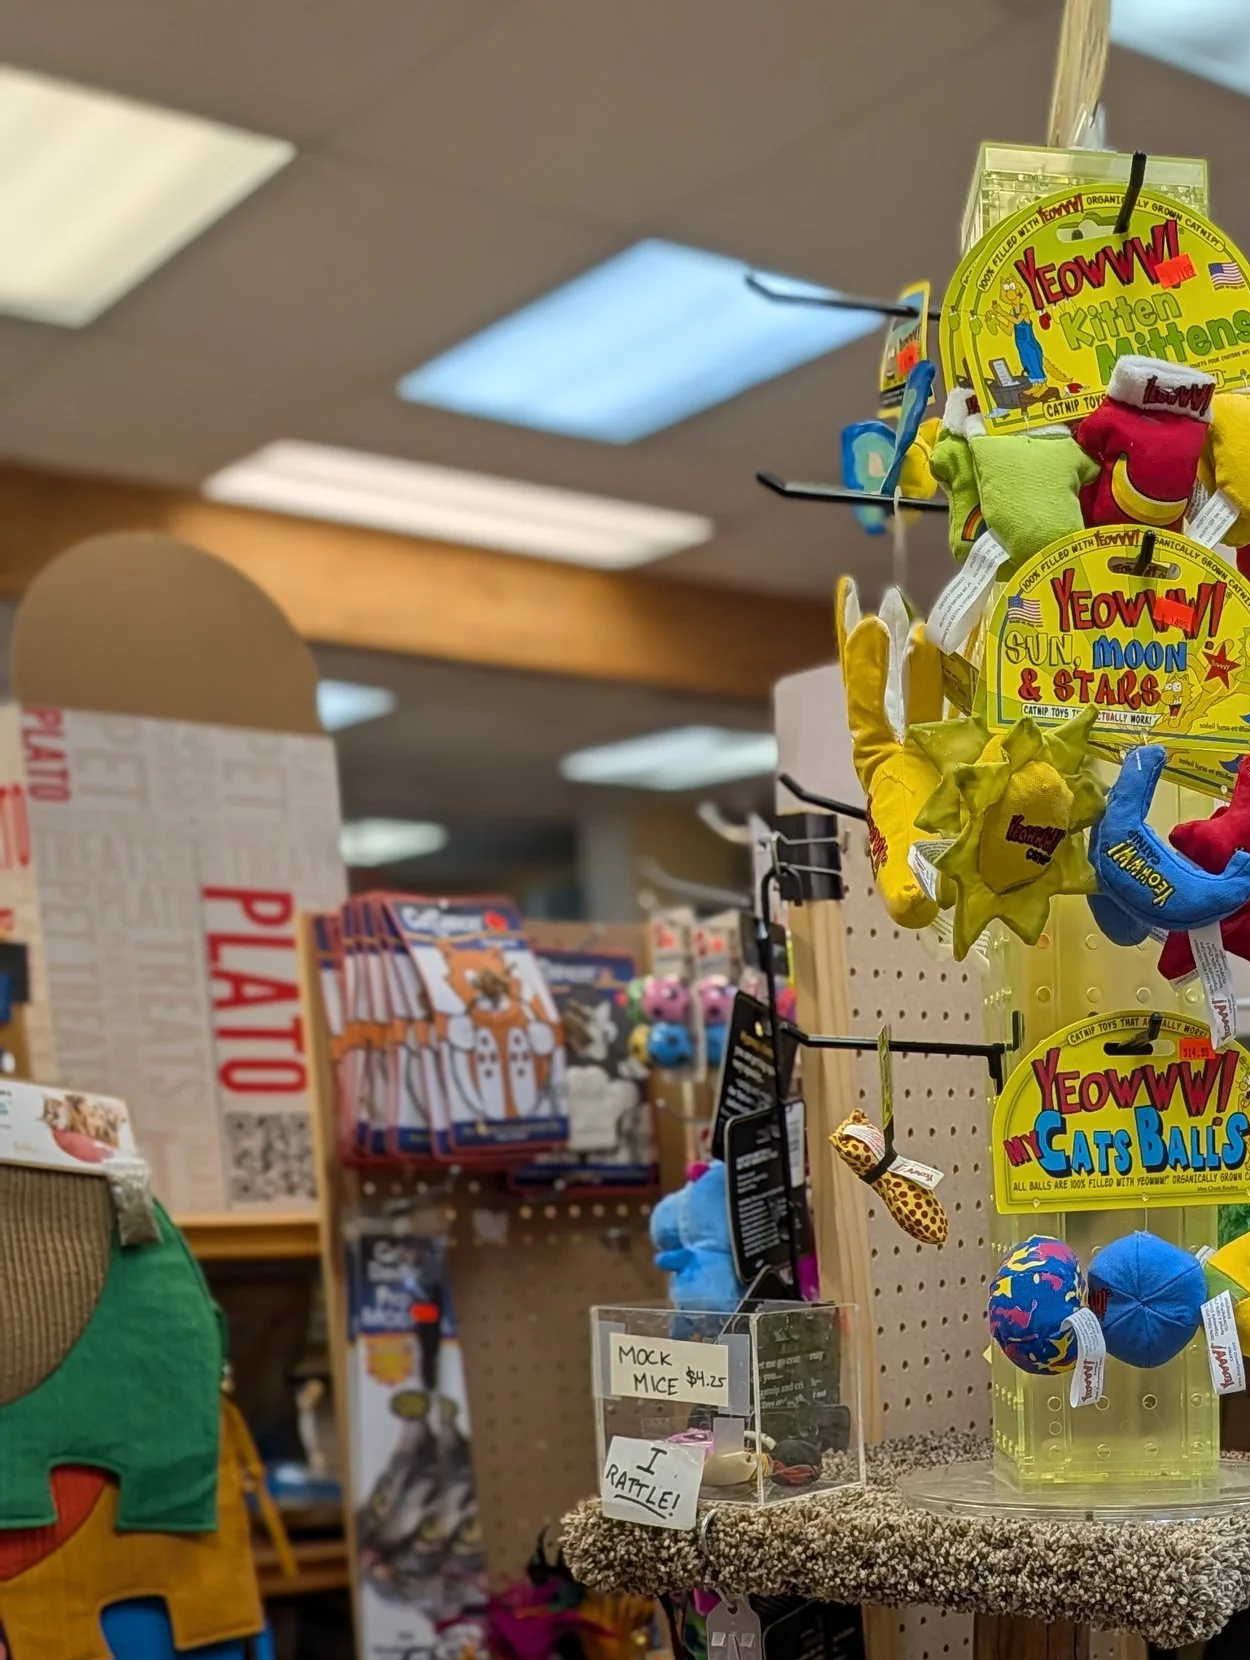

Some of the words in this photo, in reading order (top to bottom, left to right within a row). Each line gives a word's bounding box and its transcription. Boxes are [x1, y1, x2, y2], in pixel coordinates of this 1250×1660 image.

[978, 272, 995, 291] 100%
[992, 235, 1018, 267] FILLED
[1018, 217, 1040, 237] WITH
[1152, 202, 1182, 220] GROWN
[1185, 218, 1220, 246] CATNIP!
[1014, 220, 1182, 310] YEOWWW!
[1060, 292, 1182, 351] Kitten
[1046, 398, 1080, 418] CATNIP
[1022, 570, 1041, 590] 100%
[1041, 549, 1070, 572] FILLED
[1071, 540, 1095, 552] WITH
[1202, 558, 1228, 580] GROWN
[1050, 567, 1227, 649] YEOWWW!
[1005, 630, 1082, 668] SUN,
[1018, 667, 1042, 701] &
[1054, 668, 1162, 710] STARS
[1024, 705, 1048, 715] CATNIP
[1052, 707, 1069, 718] TOYS
[1130, 716, 1152, 725] WORK!
[20, 706, 70, 803] PLATO
[202, 885, 308, 1093] PLATO
[1070, 1026, 1095, 1043] CATNIP
[1099, 1020, 1117, 1031] TOYS
[1120, 1017, 1139, 1027] THAT
[1031, 1047, 1240, 1127] YEOWWW!
[1003, 1128, 1042, 1167] MY
[1033, 1109, 1133, 1176] CATS
[1135, 1105, 1250, 1175] BALLS
[1013, 1182, 1027, 1191] ALL
[1029, 1180, 1051, 1191] BALLS
[1054, 1179, 1068, 1189] ARE
[1071, 1179, 1086, 1189] 100%
[1088, 1178, 1114, 1188] FILLED
[1116, 1177, 1135, 1187] WITH
[1172, 1174, 1217, 1184] ORGANICALLY
[1220, 1173, 1243, 1182] GROWN
[619, 1346, 672, 1366] MOCK
[633, 1373, 679, 1395] MICE
[686, 1366, 726, 1388] $4.25
[636, 1447, 668, 1475] I
[606, 1464, 680, 1518] RATTLE!
